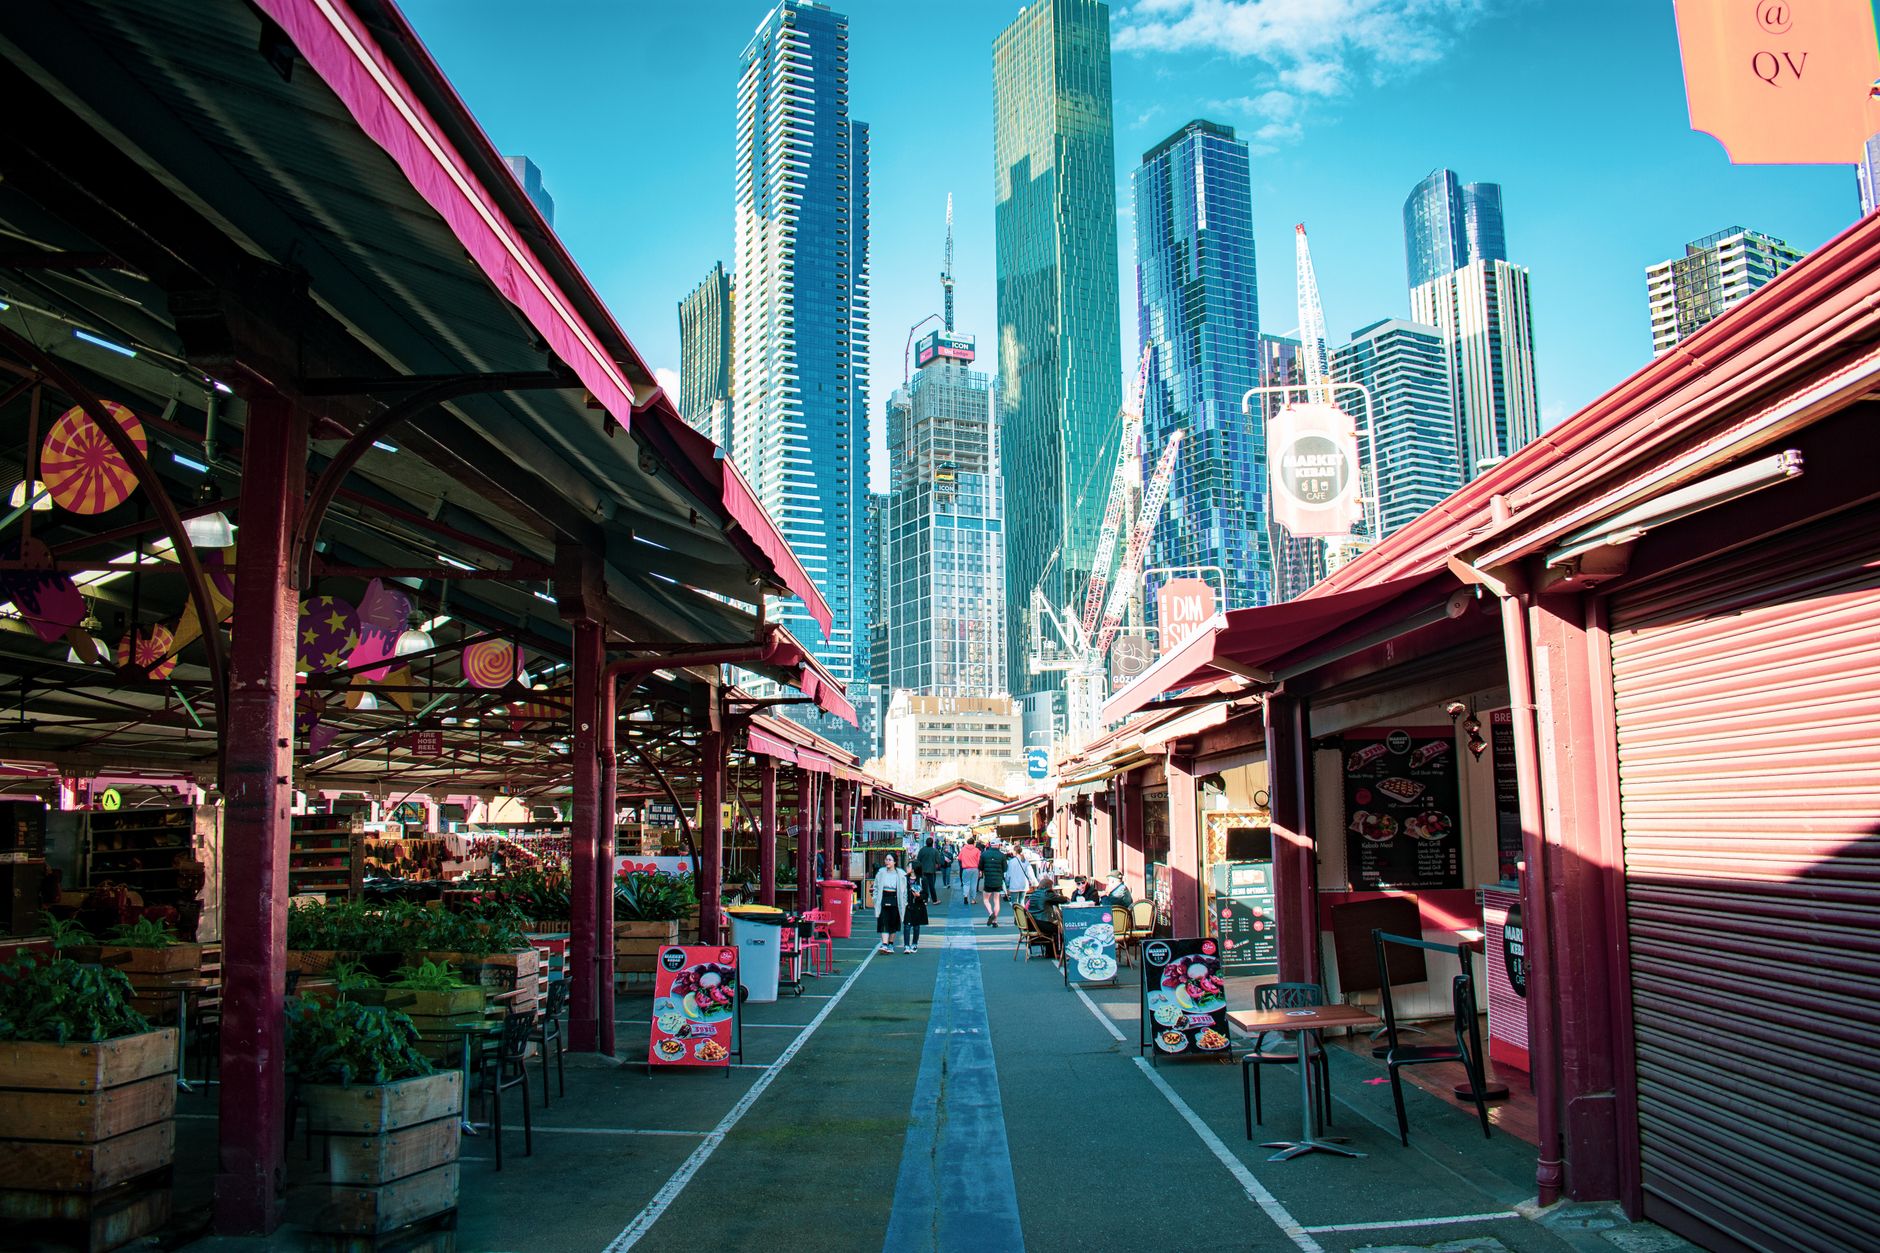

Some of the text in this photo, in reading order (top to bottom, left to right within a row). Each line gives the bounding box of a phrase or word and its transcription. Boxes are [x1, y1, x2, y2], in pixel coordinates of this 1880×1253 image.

[1756, 0, 1793, 35] @
[1752, 51, 1808, 88] QV
[951, 341, 969, 350] ICON
[1283, 453, 1344, 467] MARKET
[1296, 467, 1335, 477] KEBAB
[1173, 595, 1204, 622] DIM
[1494, 713, 1511, 722] BRE
